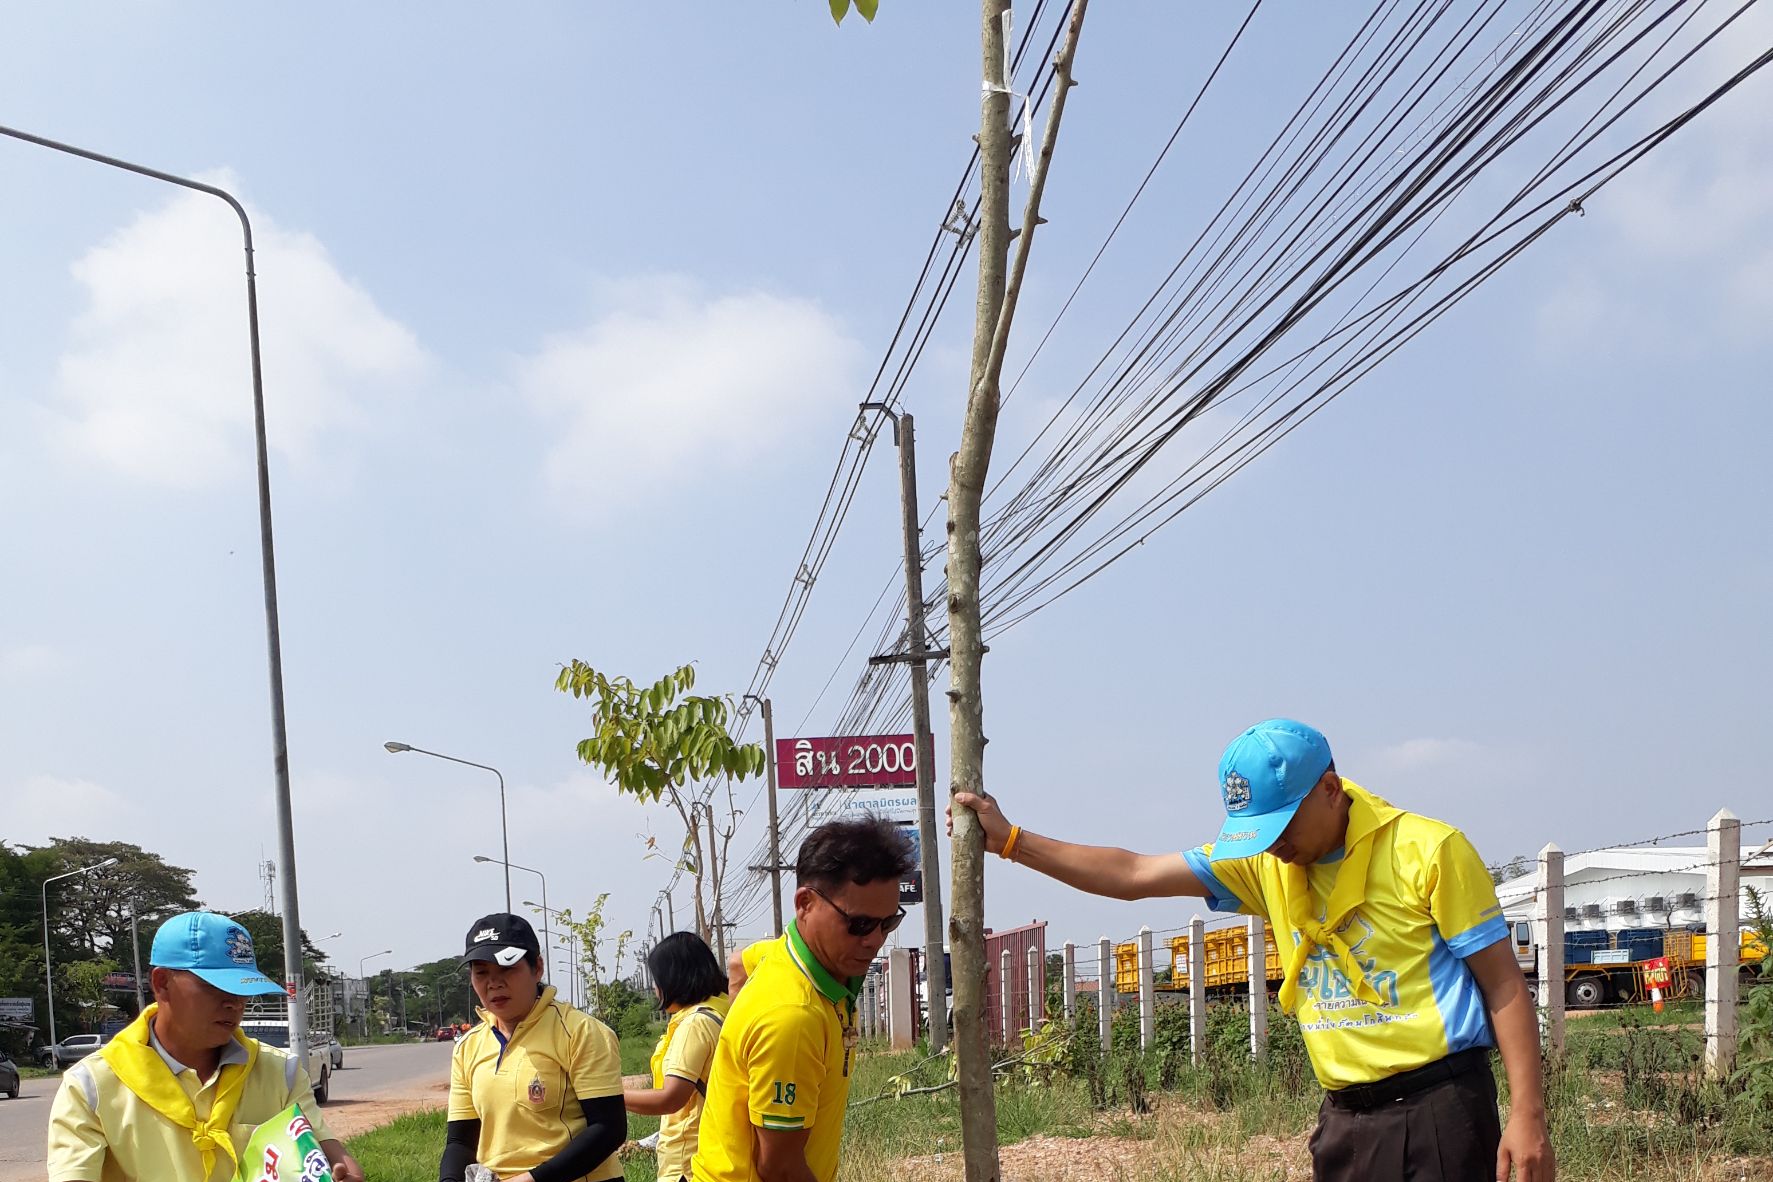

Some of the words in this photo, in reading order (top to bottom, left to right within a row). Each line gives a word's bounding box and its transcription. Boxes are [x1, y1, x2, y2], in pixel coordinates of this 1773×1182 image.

[848, 742, 917, 775] 2000
[899, 880, 917, 893] AFÉ
[771, 1080, 797, 1106] 18
